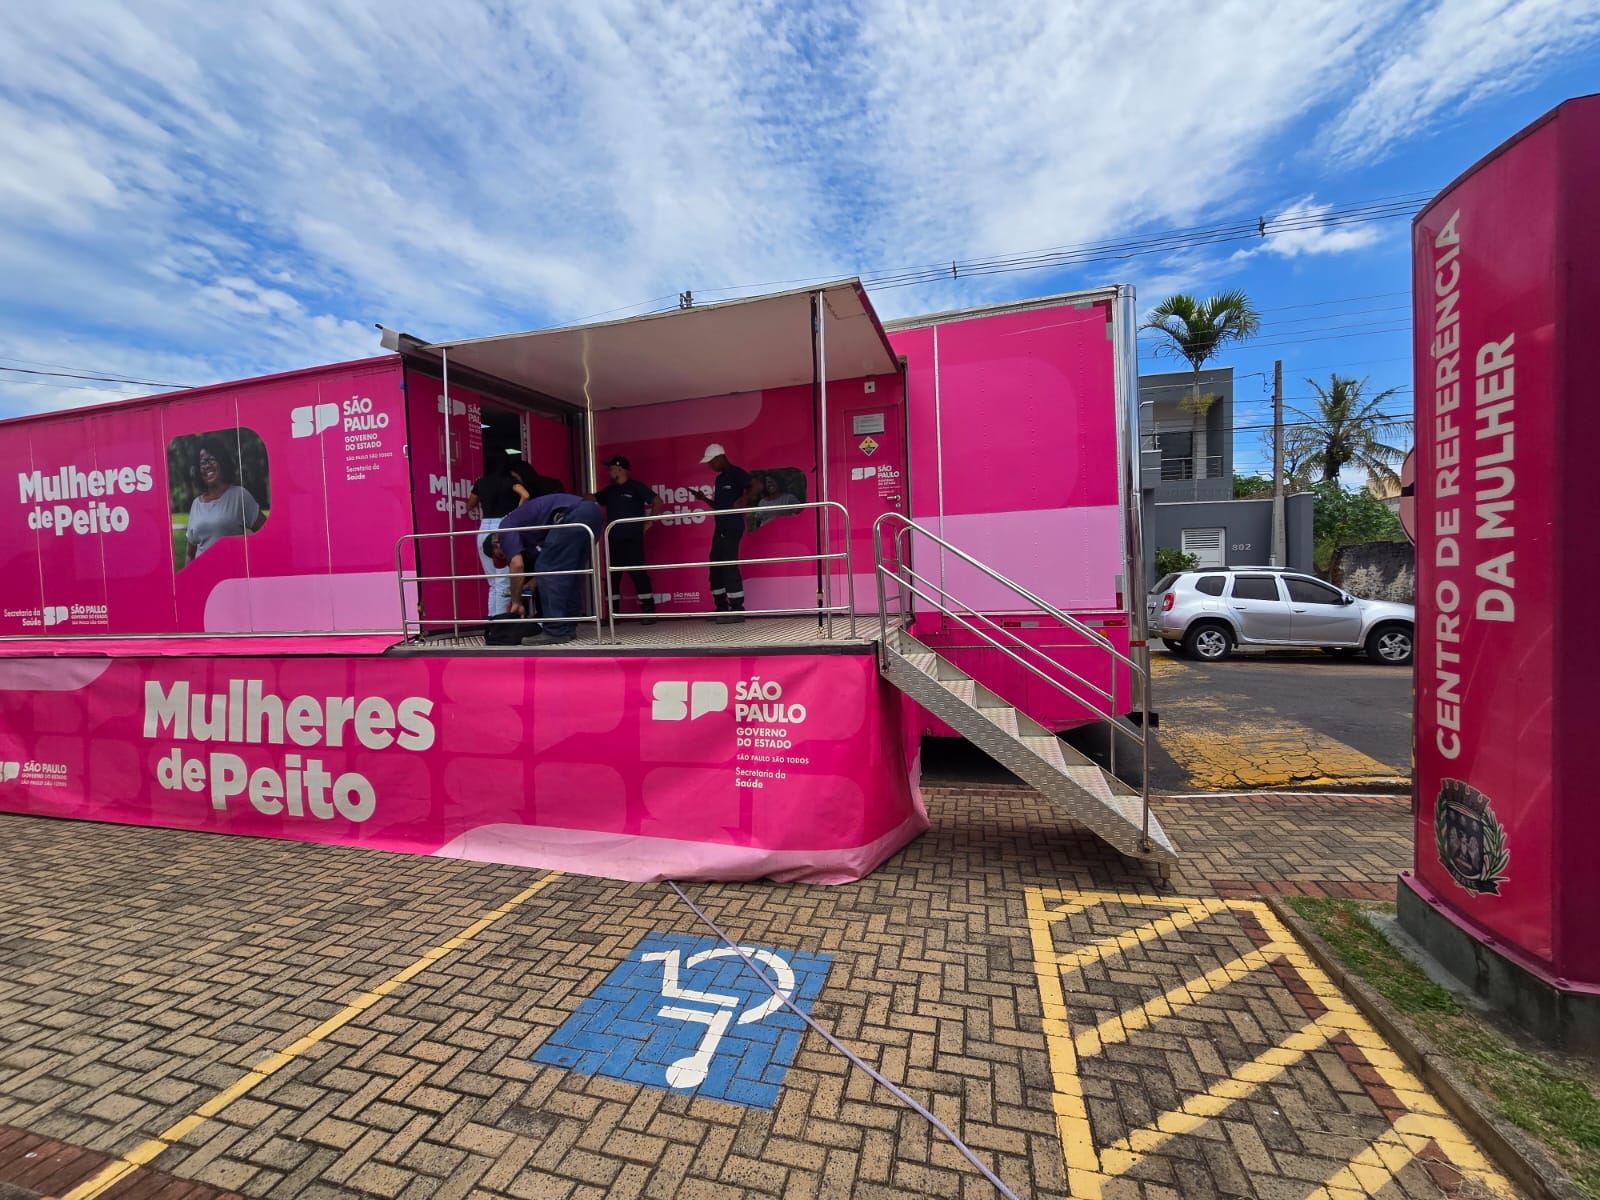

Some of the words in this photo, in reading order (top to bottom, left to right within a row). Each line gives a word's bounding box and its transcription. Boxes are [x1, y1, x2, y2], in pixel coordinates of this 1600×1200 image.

[1430, 208, 1460, 499] REFERÊNCIA
[343, 395, 373, 415] SÃO
[291, 403, 340, 439] SP
[343, 413, 390, 432] PAULO
[344, 433, 379, 443] GOVERNO
[1475, 331, 1515, 539] MULHER
[357, 441, 382, 450] ESTADO
[877, 464, 892, 472] SÃO
[877, 471, 900, 479] PAULO
[18, 465, 153, 504] Mulheres
[1232, 543, 1252, 551] 802
[1436, 508, 1460, 567] DE
[1475, 551, 1515, 622] DA
[71, 603, 85, 614] SÃO
[85, 605, 108, 614] PAULO
[1436, 579, 1461, 760] CENTRO
[735, 676, 782, 701] SÃO
[651, 681, 729, 721] SP
[143, 679, 436, 751] Mulheres
[735, 703, 806, 724] PAULO
[736, 727, 787, 738] GOVERNO
[736, 738, 752, 748] DO
[754, 738, 792, 750] ESTADO
[23, 760, 41, 772] SÃO
[42, 763, 68, 774] PAULO
[736, 753, 750, 761] SÃO
[751, 755, 771, 763] PAULO
[772, 755, 785, 764] SÃO
[786, 757, 809, 765] TODOS
[0, 761, 20, 783] P
[735, 766, 774, 778] Secretaria
[775, 768, 786, 779] da
[735, 778, 764, 789] Saúde
